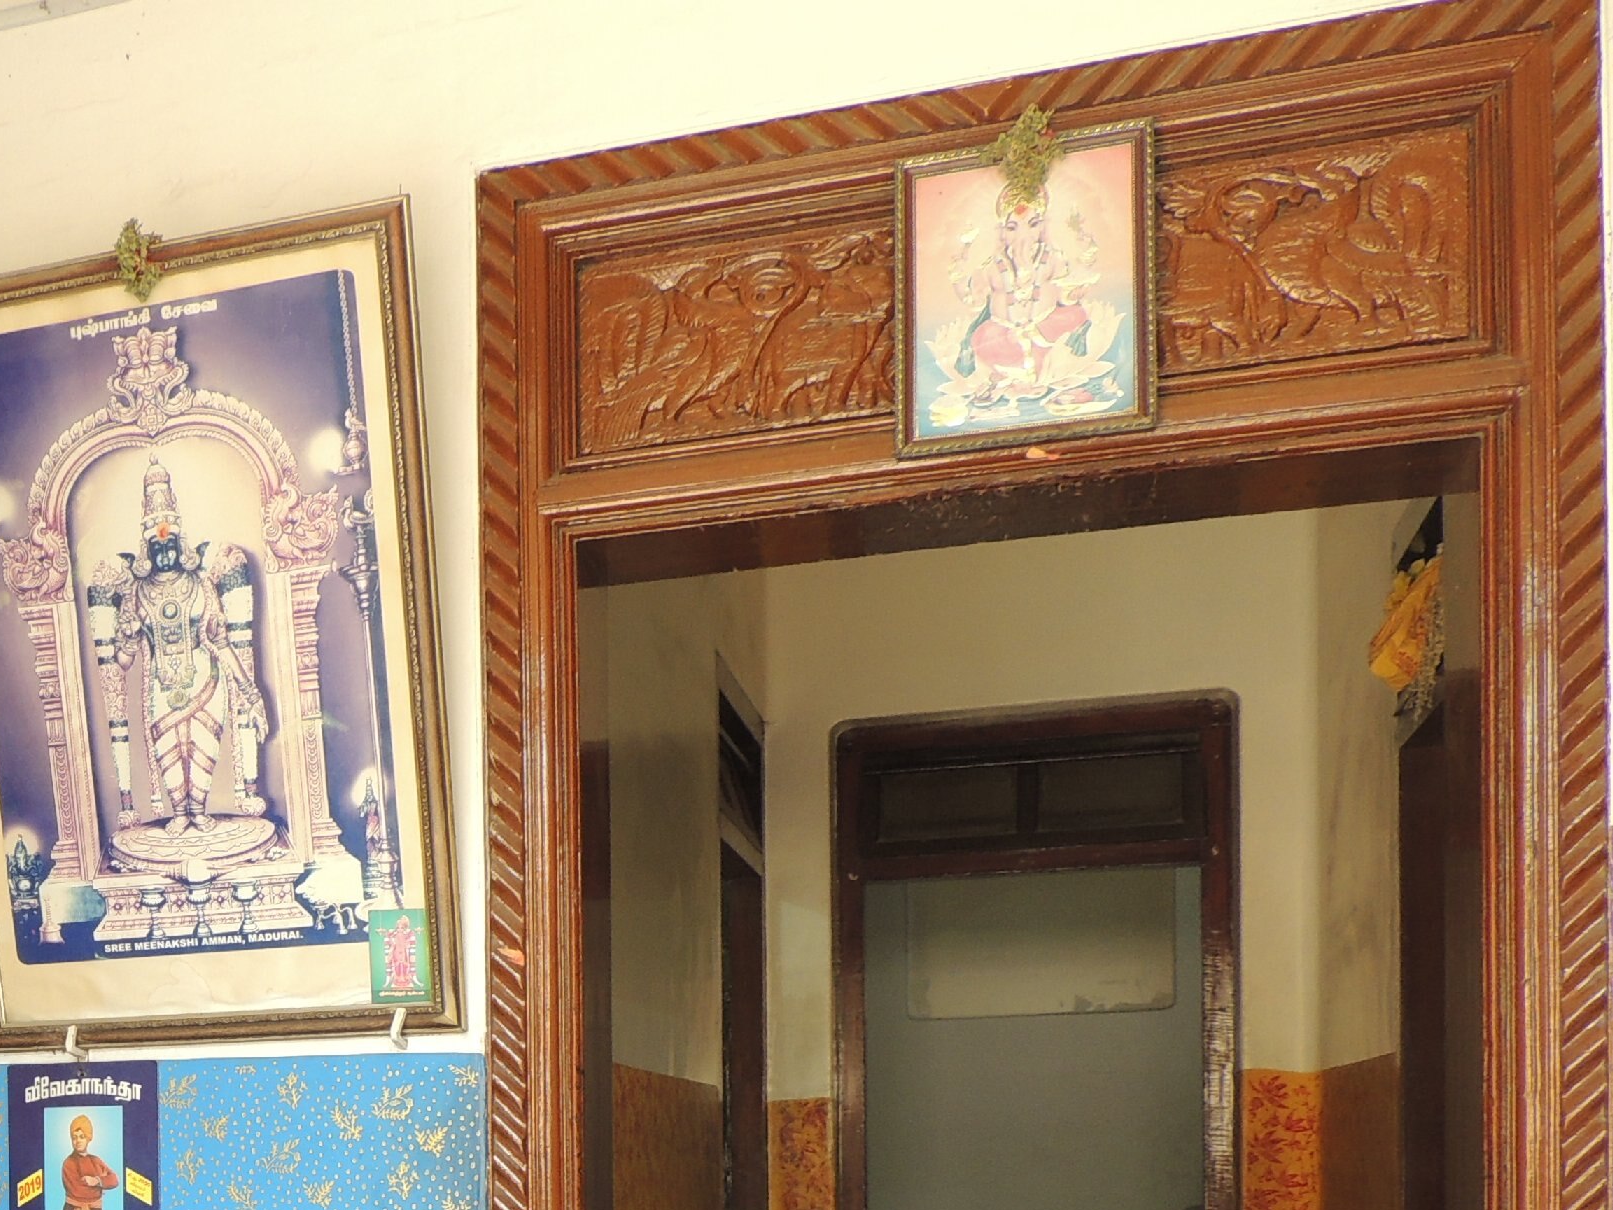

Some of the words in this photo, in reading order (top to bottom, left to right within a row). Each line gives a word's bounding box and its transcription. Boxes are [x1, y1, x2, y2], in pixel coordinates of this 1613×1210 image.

[161, 299, 218, 320] சேவை
[105, 944, 132, 953] SREE
[134, 939, 198, 951] MEENAKSHI
[201, 935, 245, 946] AMMAN,
[248, 930, 303, 943] MADURAI.
[19, 1176, 41, 1200] 2019
